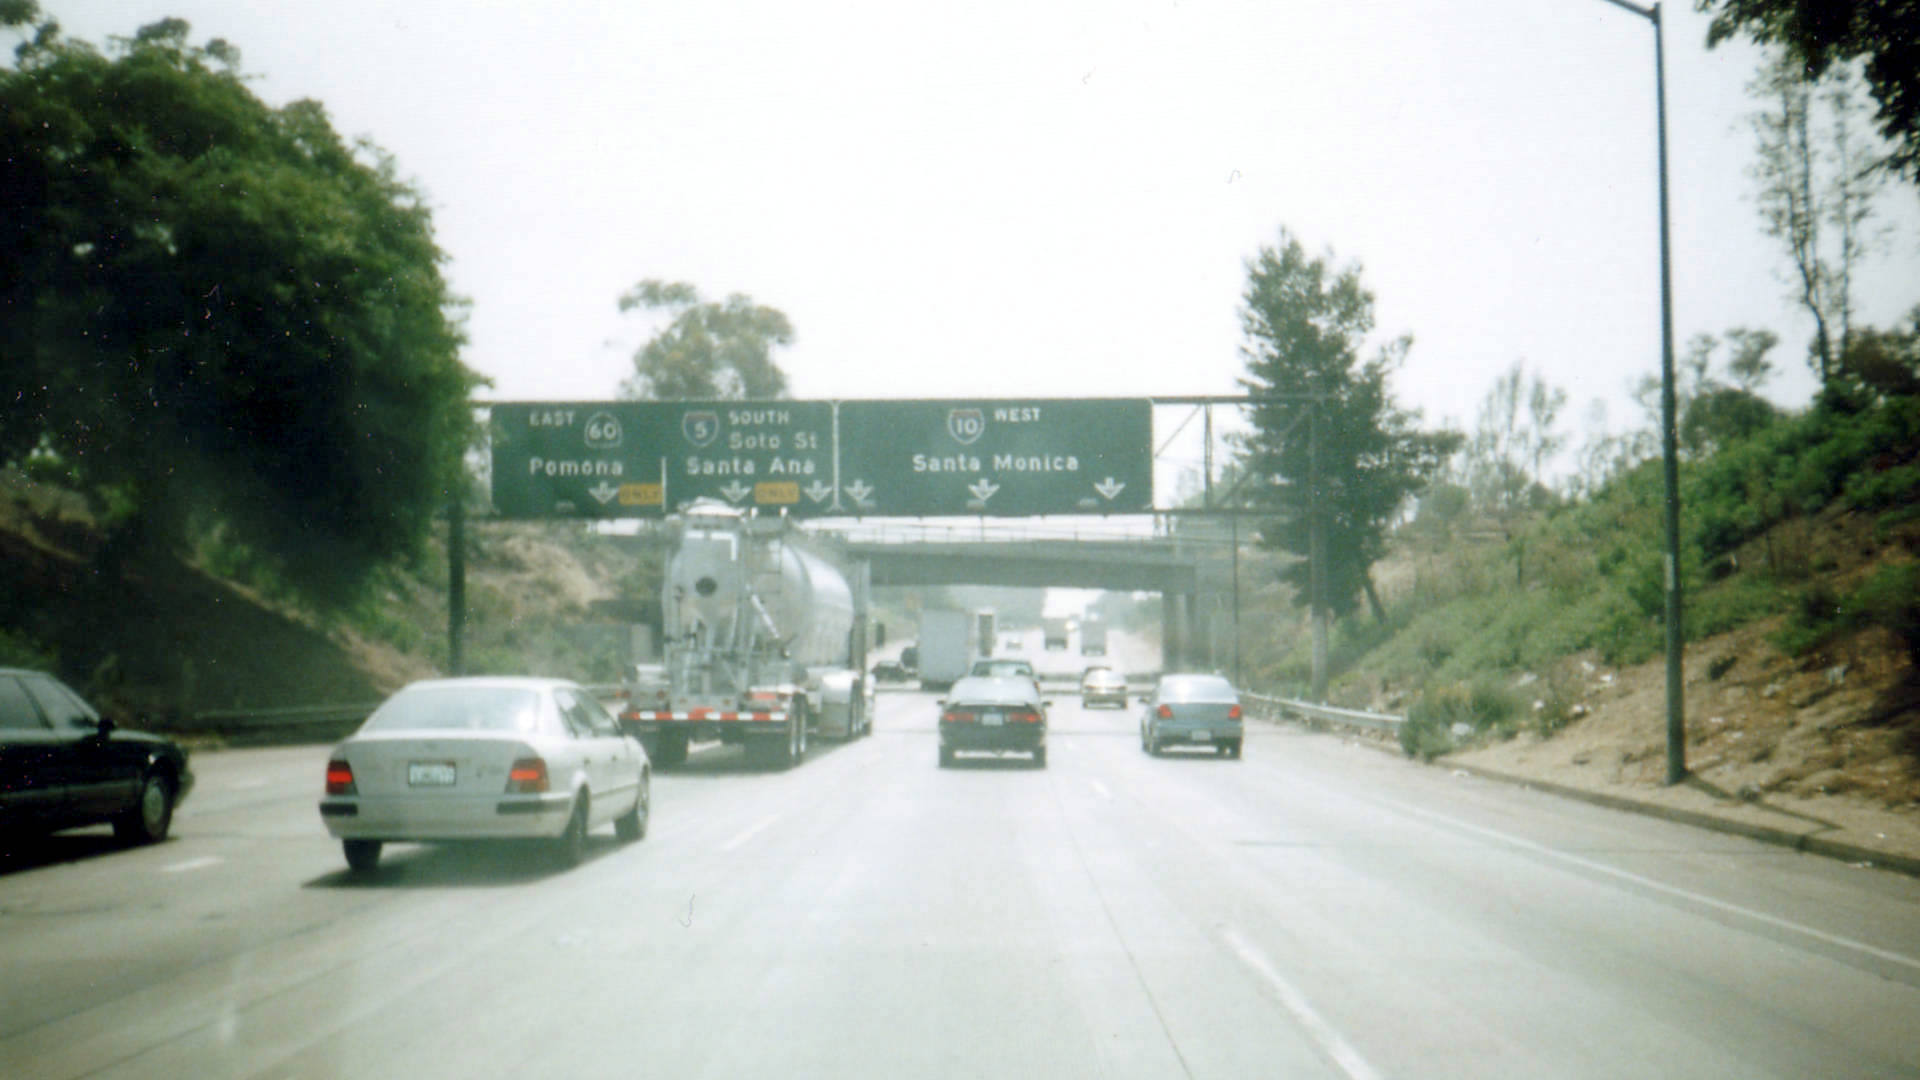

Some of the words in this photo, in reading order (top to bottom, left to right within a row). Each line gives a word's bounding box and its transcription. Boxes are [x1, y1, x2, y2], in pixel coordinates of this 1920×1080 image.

[529, 411, 575, 426] EAST
[729, 410, 789, 425] SOUTH
[994, 407, 1041, 422] WEST
[588, 421, 617, 440] 60
[694, 423, 707, 439] 5
[955, 418, 978, 435] 10
[729, 432, 779, 449] Soto
[794, 432, 817, 449] St
[529, 457, 623, 476] Pomona
[686, 457, 755, 475] Santa
[769, 457, 815, 474] Ana
[912, 454, 981, 472] Santa
[994, 454, 1080, 472] Monica
